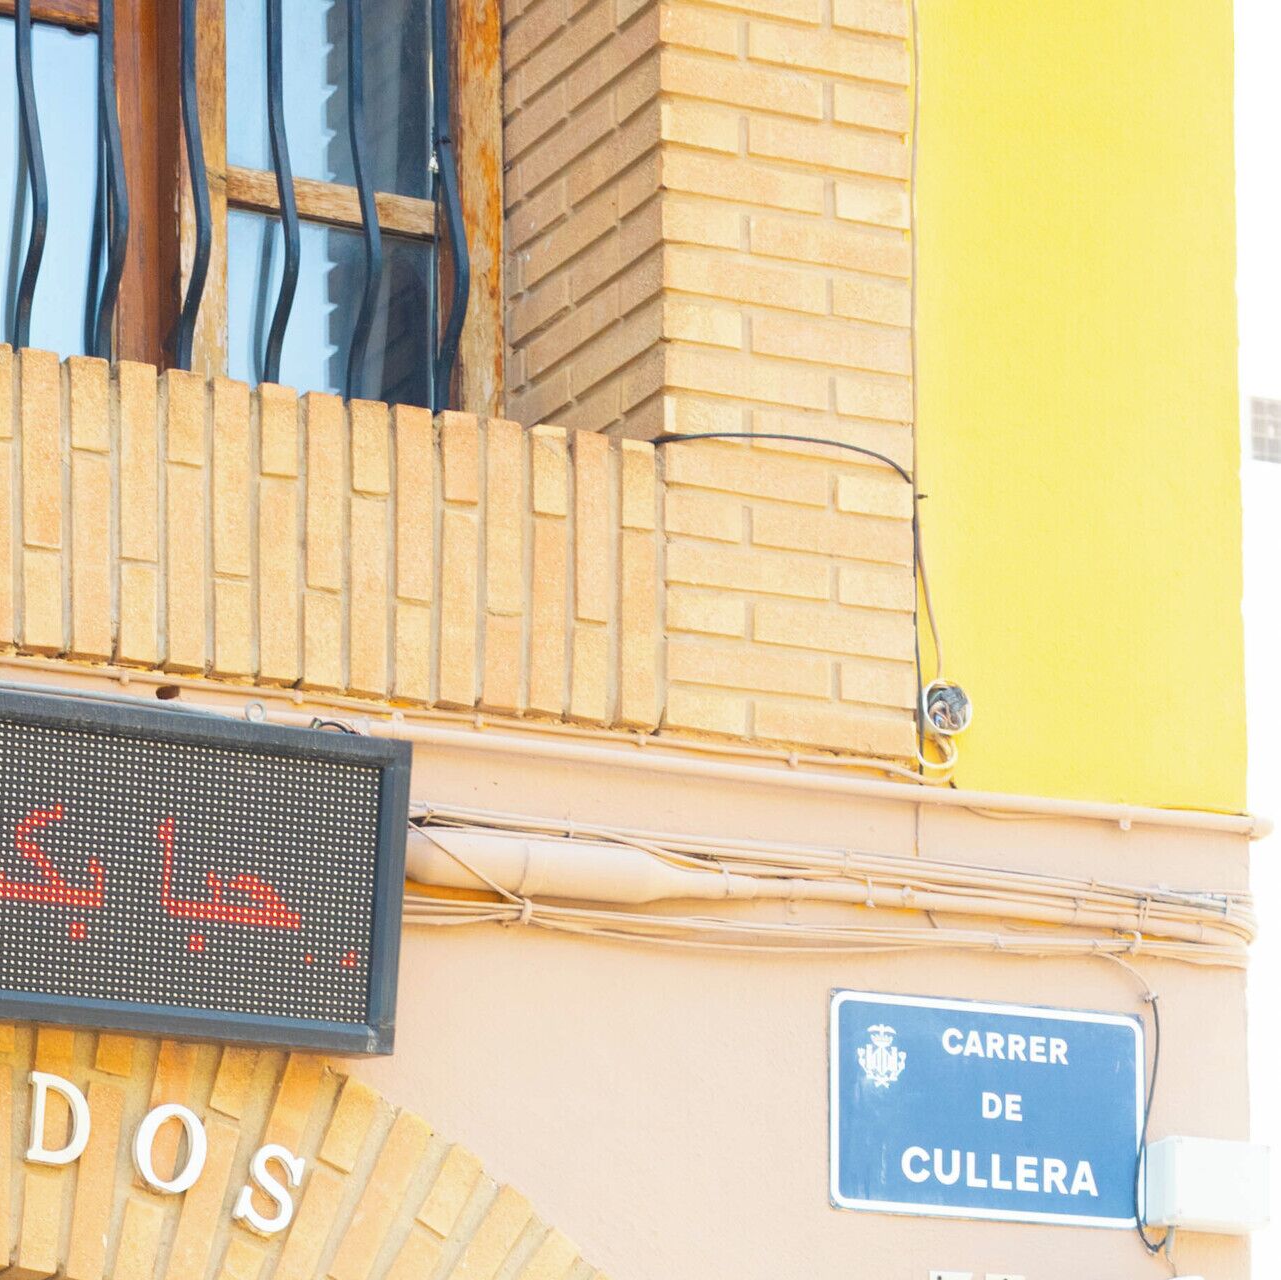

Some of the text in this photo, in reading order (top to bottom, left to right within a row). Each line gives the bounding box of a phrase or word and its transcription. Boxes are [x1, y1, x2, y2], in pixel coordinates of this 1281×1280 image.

[941, 1027, 1069, 1066] CARRER
[981, 1092, 1023, 1122] DE
[901, 1145, 1099, 1198] CULLERA
